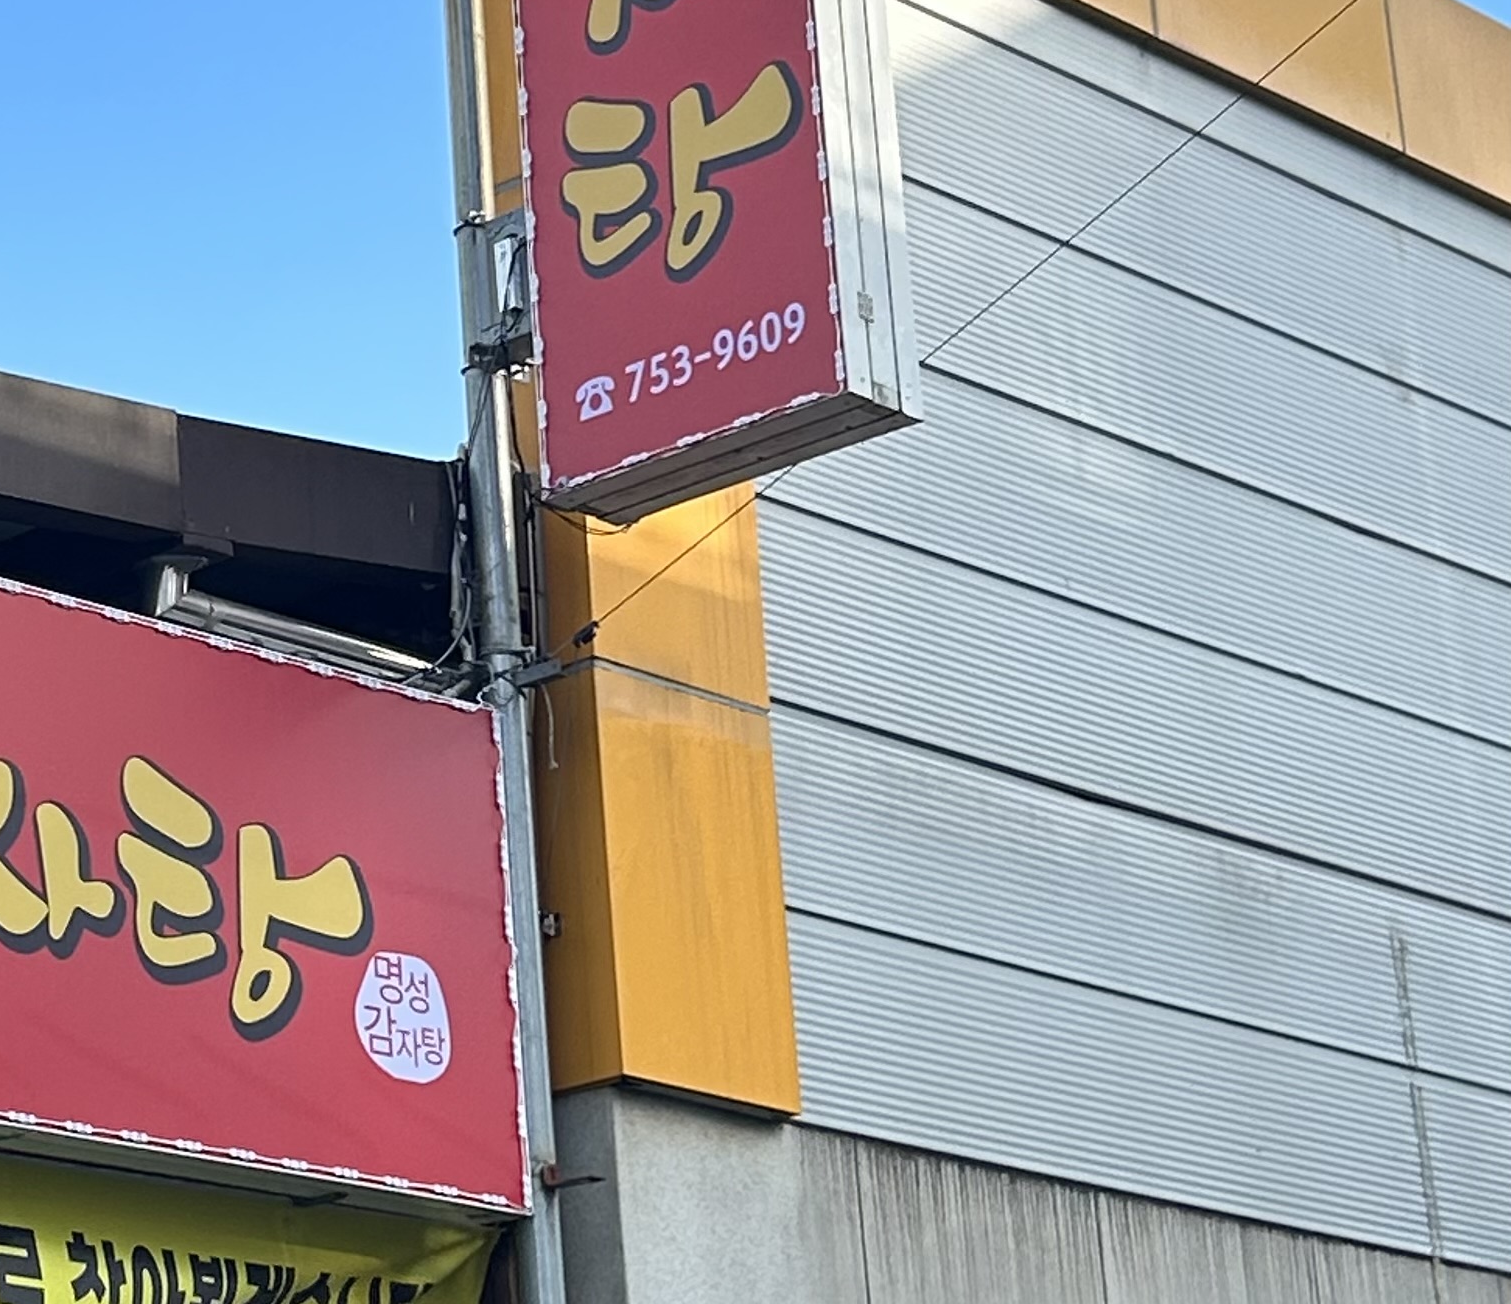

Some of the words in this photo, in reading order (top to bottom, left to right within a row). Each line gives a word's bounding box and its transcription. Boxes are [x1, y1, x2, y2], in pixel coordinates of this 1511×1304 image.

[624, 302, 806, 405] 753-9609
[374, 956, 429, 1014] 명성
[364, 1005, 445, 1068] 감자탕
